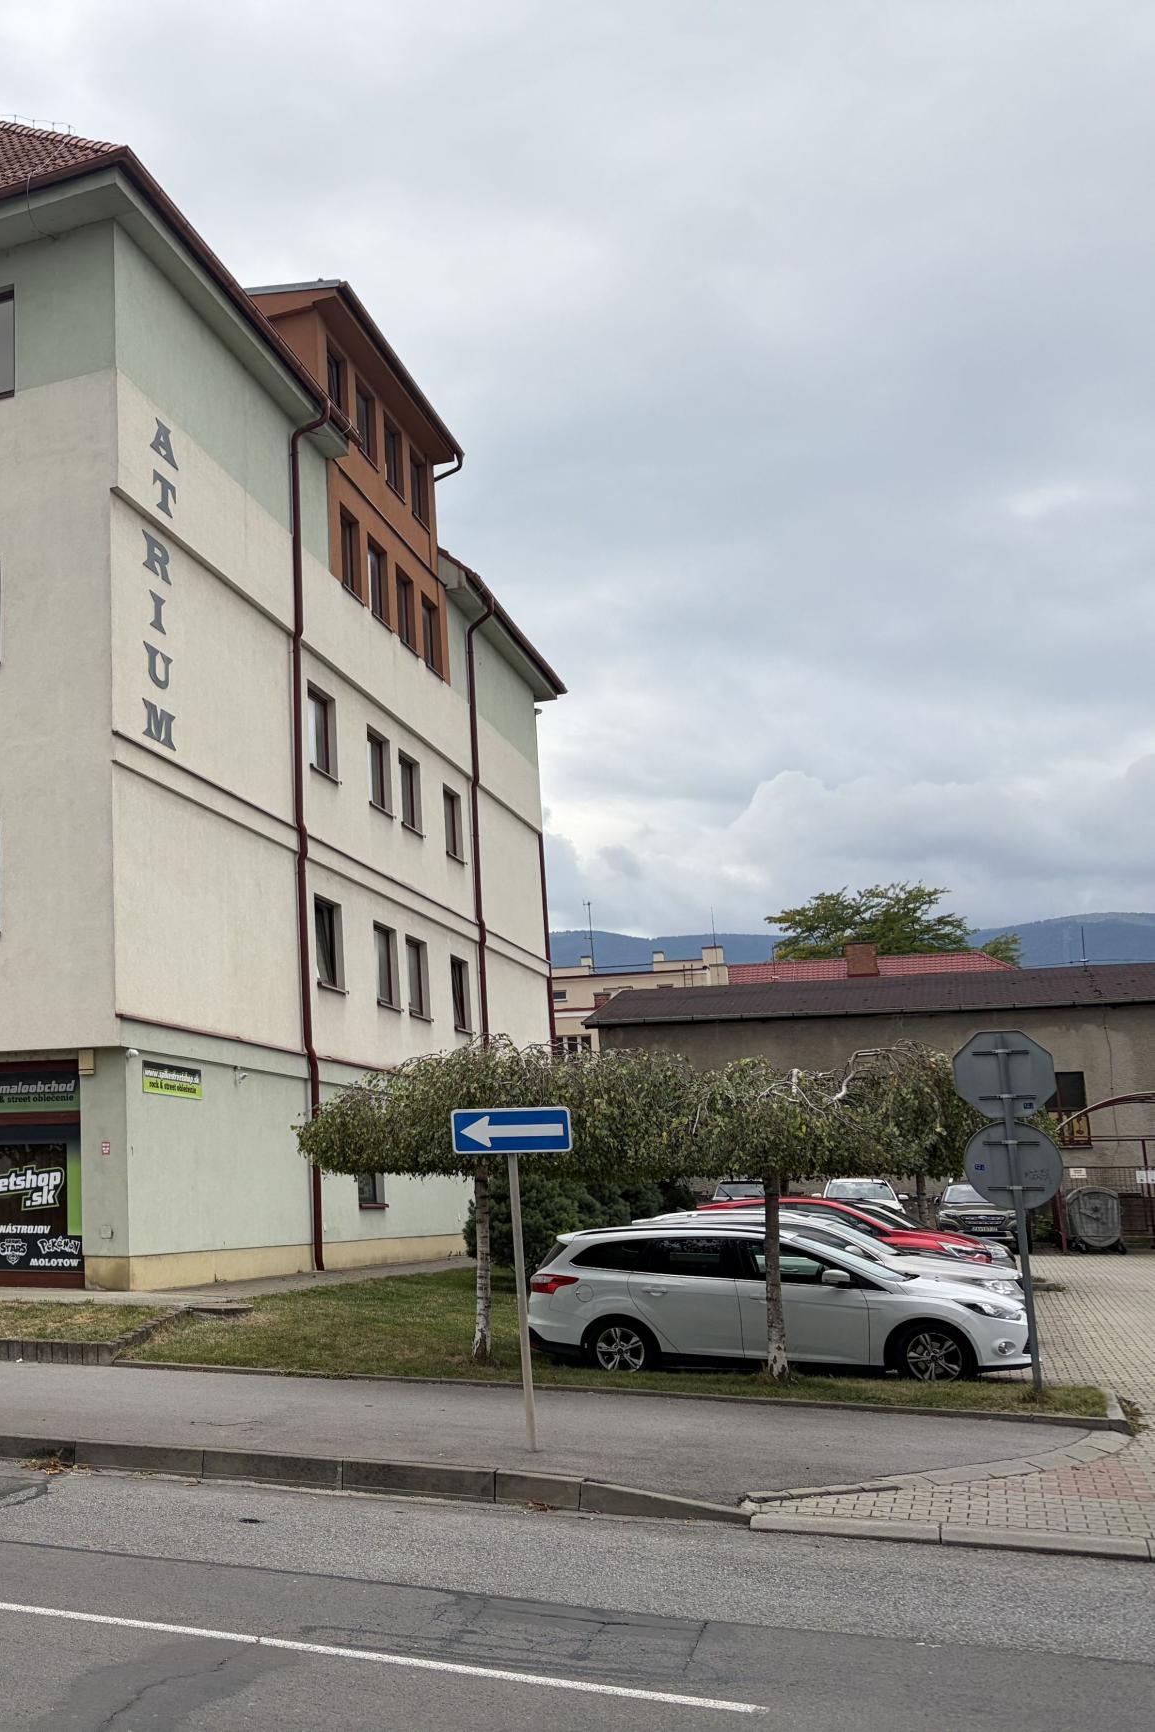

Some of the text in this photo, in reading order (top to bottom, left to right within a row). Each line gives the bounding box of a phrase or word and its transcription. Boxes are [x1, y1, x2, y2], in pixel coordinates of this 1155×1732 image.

[141, 416, 180, 752] ATRIUM
[0, 1096, 5, 1104] &
[7, 1095, 31, 1103] street
[32, 1094, 74, 1103] oblečenie
[25, 1186, 56, 1206] .sk
[0, 1223, 51, 1234] NÁSTROJOV
[29, 1258, 80, 1267] MOLOTOW
